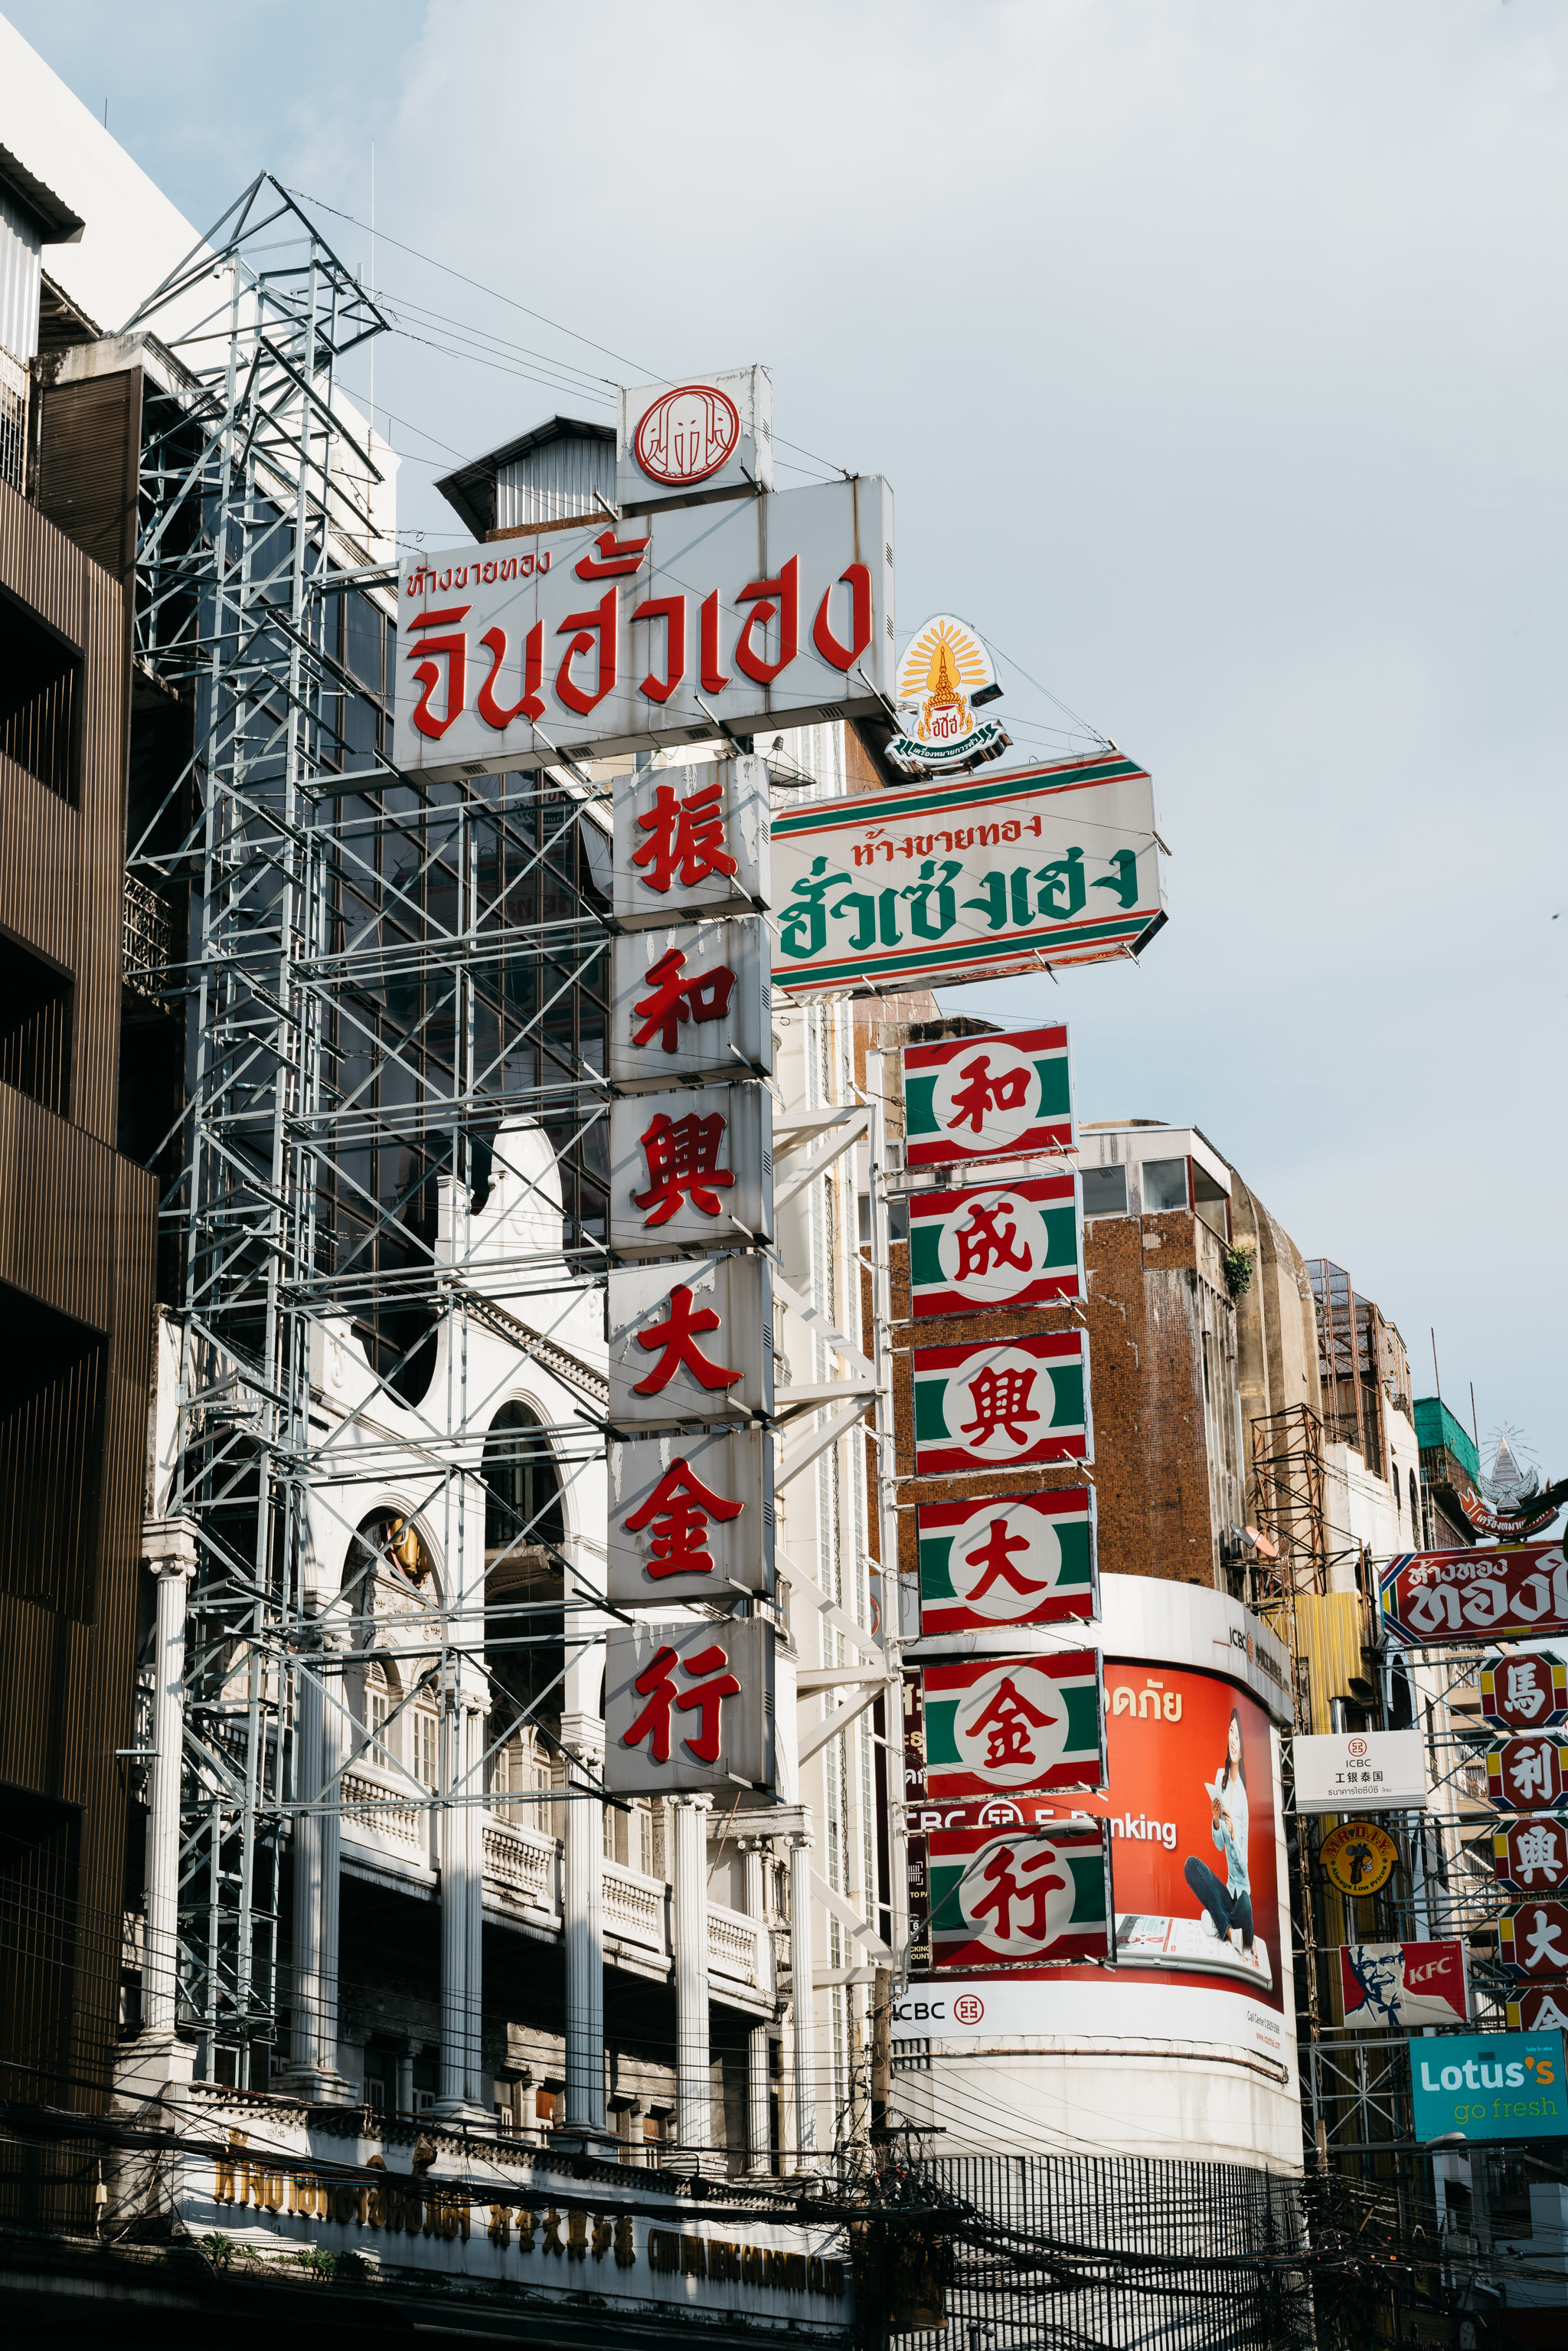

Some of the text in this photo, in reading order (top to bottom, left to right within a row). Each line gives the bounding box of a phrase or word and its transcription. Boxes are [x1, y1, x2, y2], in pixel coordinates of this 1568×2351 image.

[407, 551, 551, 597] ห้างขายทอง
[913, 737, 978, 757] เครื่องหมายการค้า
[851, 815, 1042, 867] ห้างขายทอง
[776, 845, 1139, 959] ฮั่วเซ่งเฮง
[1407, 1558, 1508, 1585] ห้างทอง
[1229, 1627, 1246, 1653] ICBC
[1346, 1759, 1371, 1767] ICBC
[1328, 1785, 1379, 1796] ธนาคารไอซีบีซี
[1335, 1771, 1383, 1784] 工银泰国
[1331, 1867, 1352, 1890] Always
[1370, 1865, 1387, 1888] Prices
[1409, 1957, 1452, 1985] KFC
[893, 2002, 946, 2021] ICBC
[1454, 2096, 1558, 2125] go fresh
